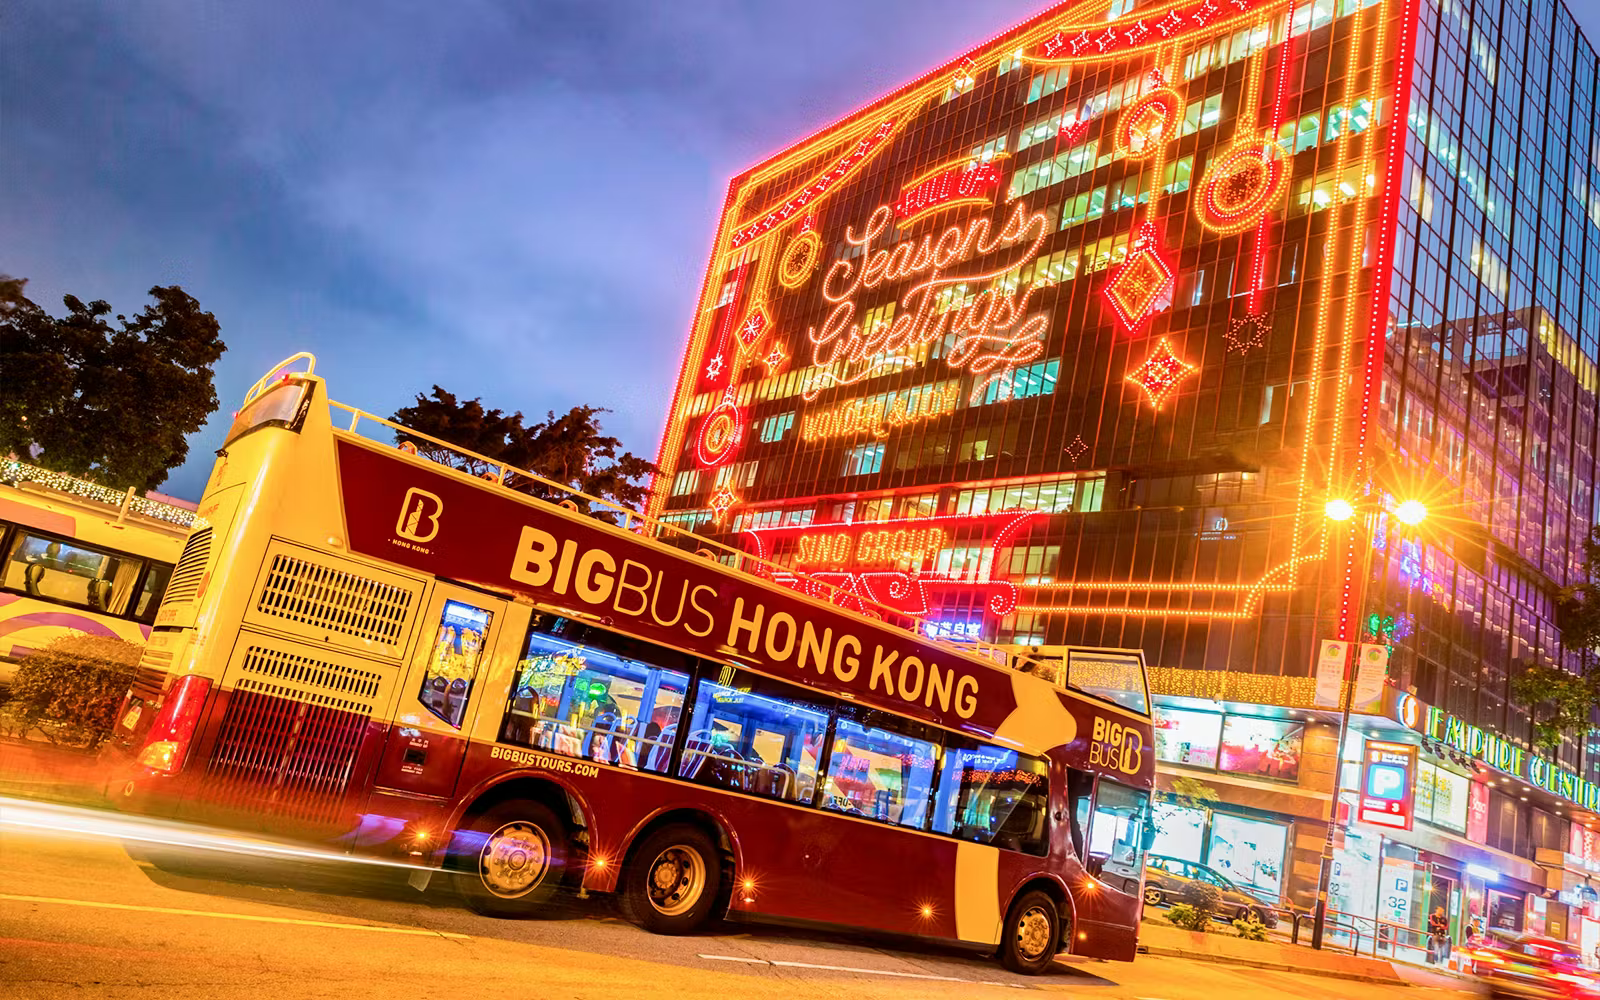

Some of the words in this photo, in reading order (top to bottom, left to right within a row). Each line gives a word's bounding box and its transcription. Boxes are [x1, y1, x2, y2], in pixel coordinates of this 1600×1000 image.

[905, 171, 949, 216] FULL
[958, 164, 990, 196] OF
[804, 274, 1055, 388] Greetings
[803, 399, 888, 442] WONDER
[392, 539, 411, 549] HONG
[412, 545, 430, 555] KONG
[795, 533, 851, 563] SINO
[857, 528, 947, 562] GROUP
[727, 597, 862, 682] HONG
[869, 645, 979, 719] KONG
[1093, 716, 1122, 747] BIG
[490, 746, 599, 779] BIGBUSTOURS.COM
[1089, 741, 1119, 770] BUS
[1424, 705, 1526, 780] EMPIRE
[1528, 755, 1600, 815] CENTR
[1329, 882, 1340, 896] 32
[1388, 896, 1407, 911] 32
